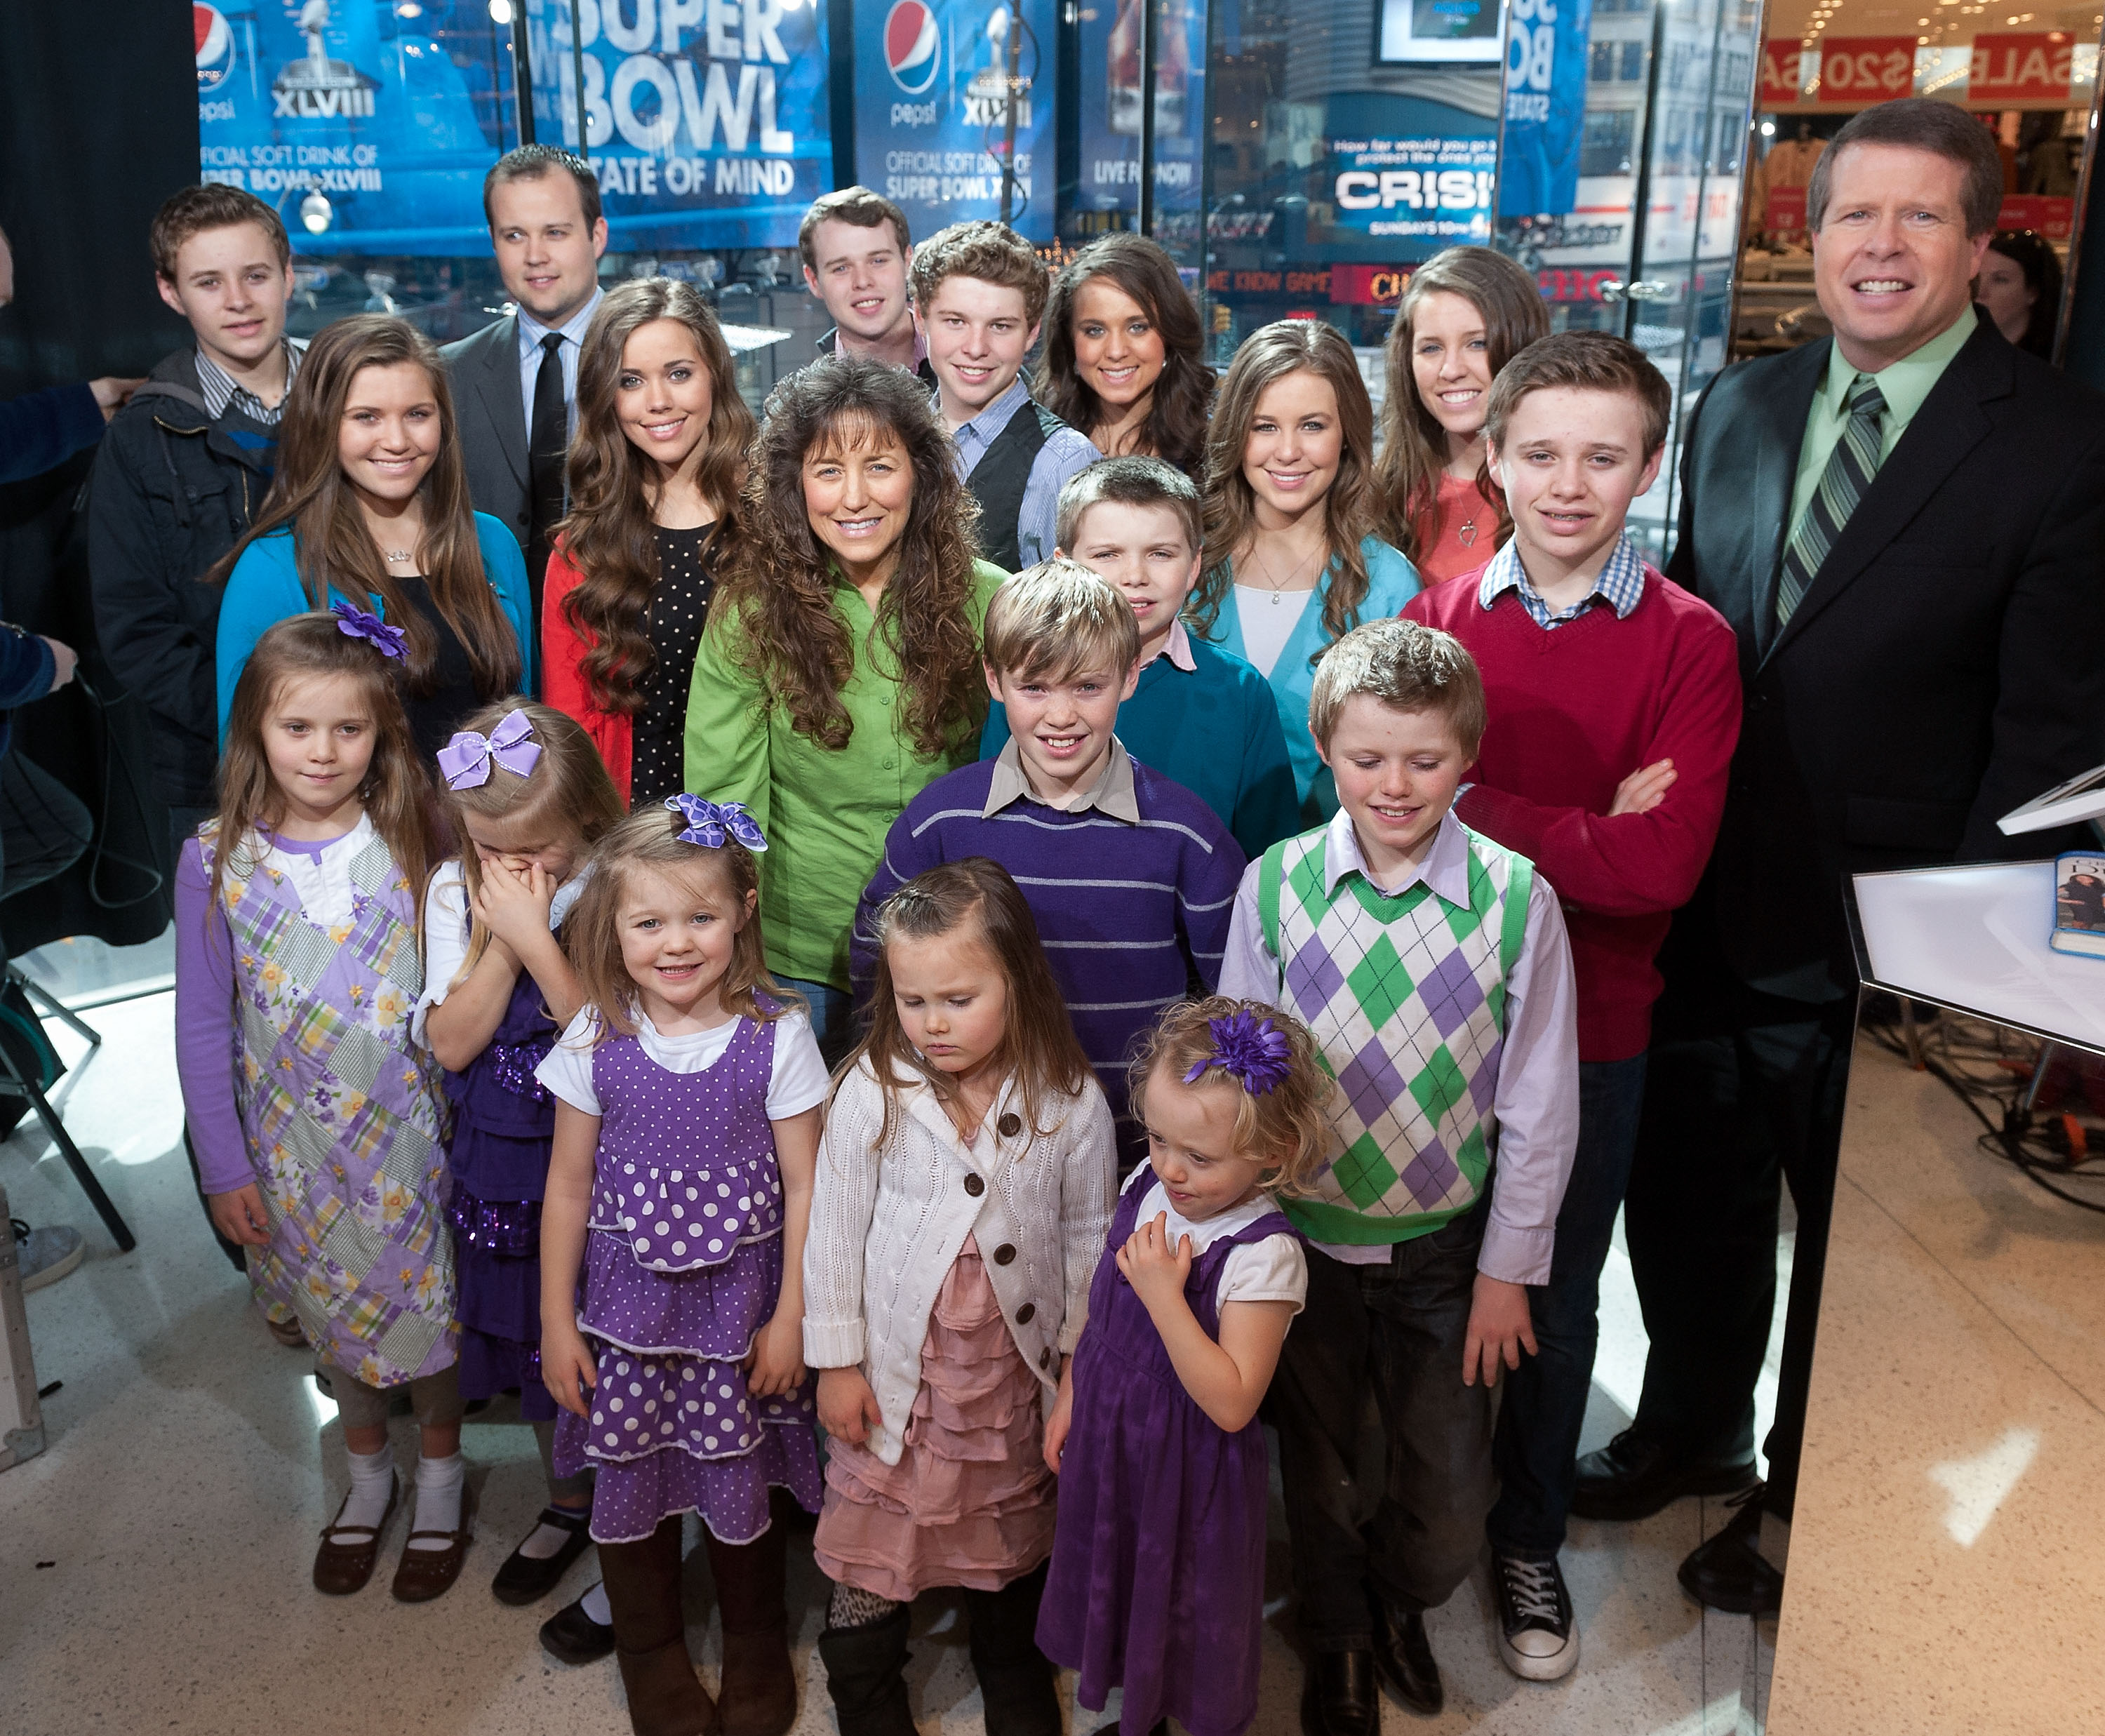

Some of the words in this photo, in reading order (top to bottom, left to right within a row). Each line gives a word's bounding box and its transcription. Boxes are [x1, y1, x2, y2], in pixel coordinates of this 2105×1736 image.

[552, 0, 790, 64] SUPER
[272, 88, 375, 118] XLVIII
[559, 51, 794, 152] BOWL
[890, 101, 936, 128] pepsi
[963, 96, 1032, 128] XLVII
[250, 145, 293, 166] SOFT
[297, 146, 351, 166] DRINK
[353, 145, 377, 166] OF
[1394, 138, 1441, 152] would
[1442, 141, 1469, 153] you
[1470, 141, 1488, 153] go
[1410, 151, 1436, 164] the
[886, 151, 942, 174] OFFICIAL
[944, 152, 976, 175] SOFT
[1013, 153, 1032, 175] OF
[1094, 159, 1126, 184] LIVE
[1154, 161, 1192, 185] NOW
[320, 168, 383, 192] XLVIII
[665, 157, 706, 196] OF
[714, 158, 794, 196] MIND
[886, 176, 939, 199] SUPER
[942, 177, 989, 199] BOWL
[1335, 171, 1495, 209] CRISI
